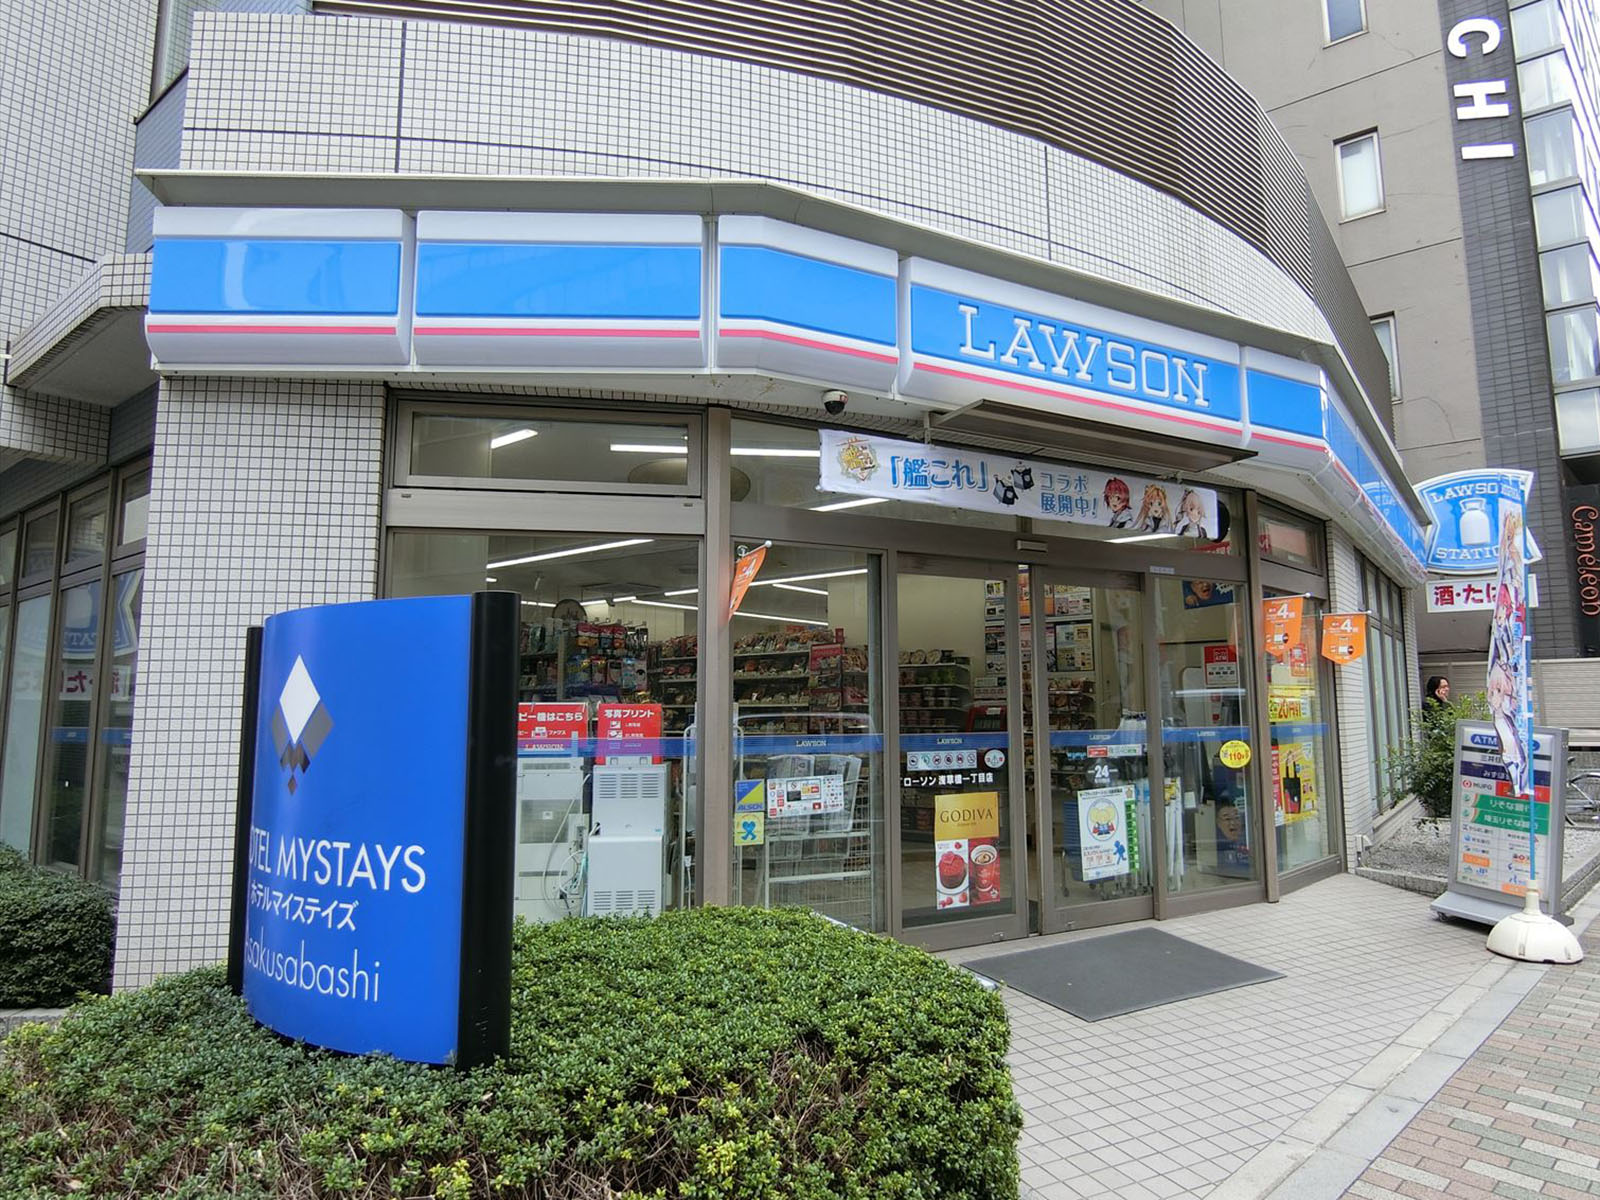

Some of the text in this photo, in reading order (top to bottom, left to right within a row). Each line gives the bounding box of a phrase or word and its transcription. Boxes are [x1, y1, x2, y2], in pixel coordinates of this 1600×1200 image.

[958, 301, 1210, 408] LAWSON
[890, 455, 989, 492] 「艦これ」
[1430, 482, 1499, 503] LAWSO
[1436, 545, 1499, 560] STATI
[1434, 583, 1497, 605] 酒・た
[518, 711, 583, 722] ピー機はこちら
[604, 709, 655, 719] 写真プリント
[1473, 736, 1497, 746] ATM
[1094, 765, 1110, 778] 24
[903, 775, 937, 786] ローソン
[940, 808, 993, 823] GODIVA
[249, 825, 426, 893] OTEL MYSTAYS
[246, 925, 380, 1002] sakusabashi
